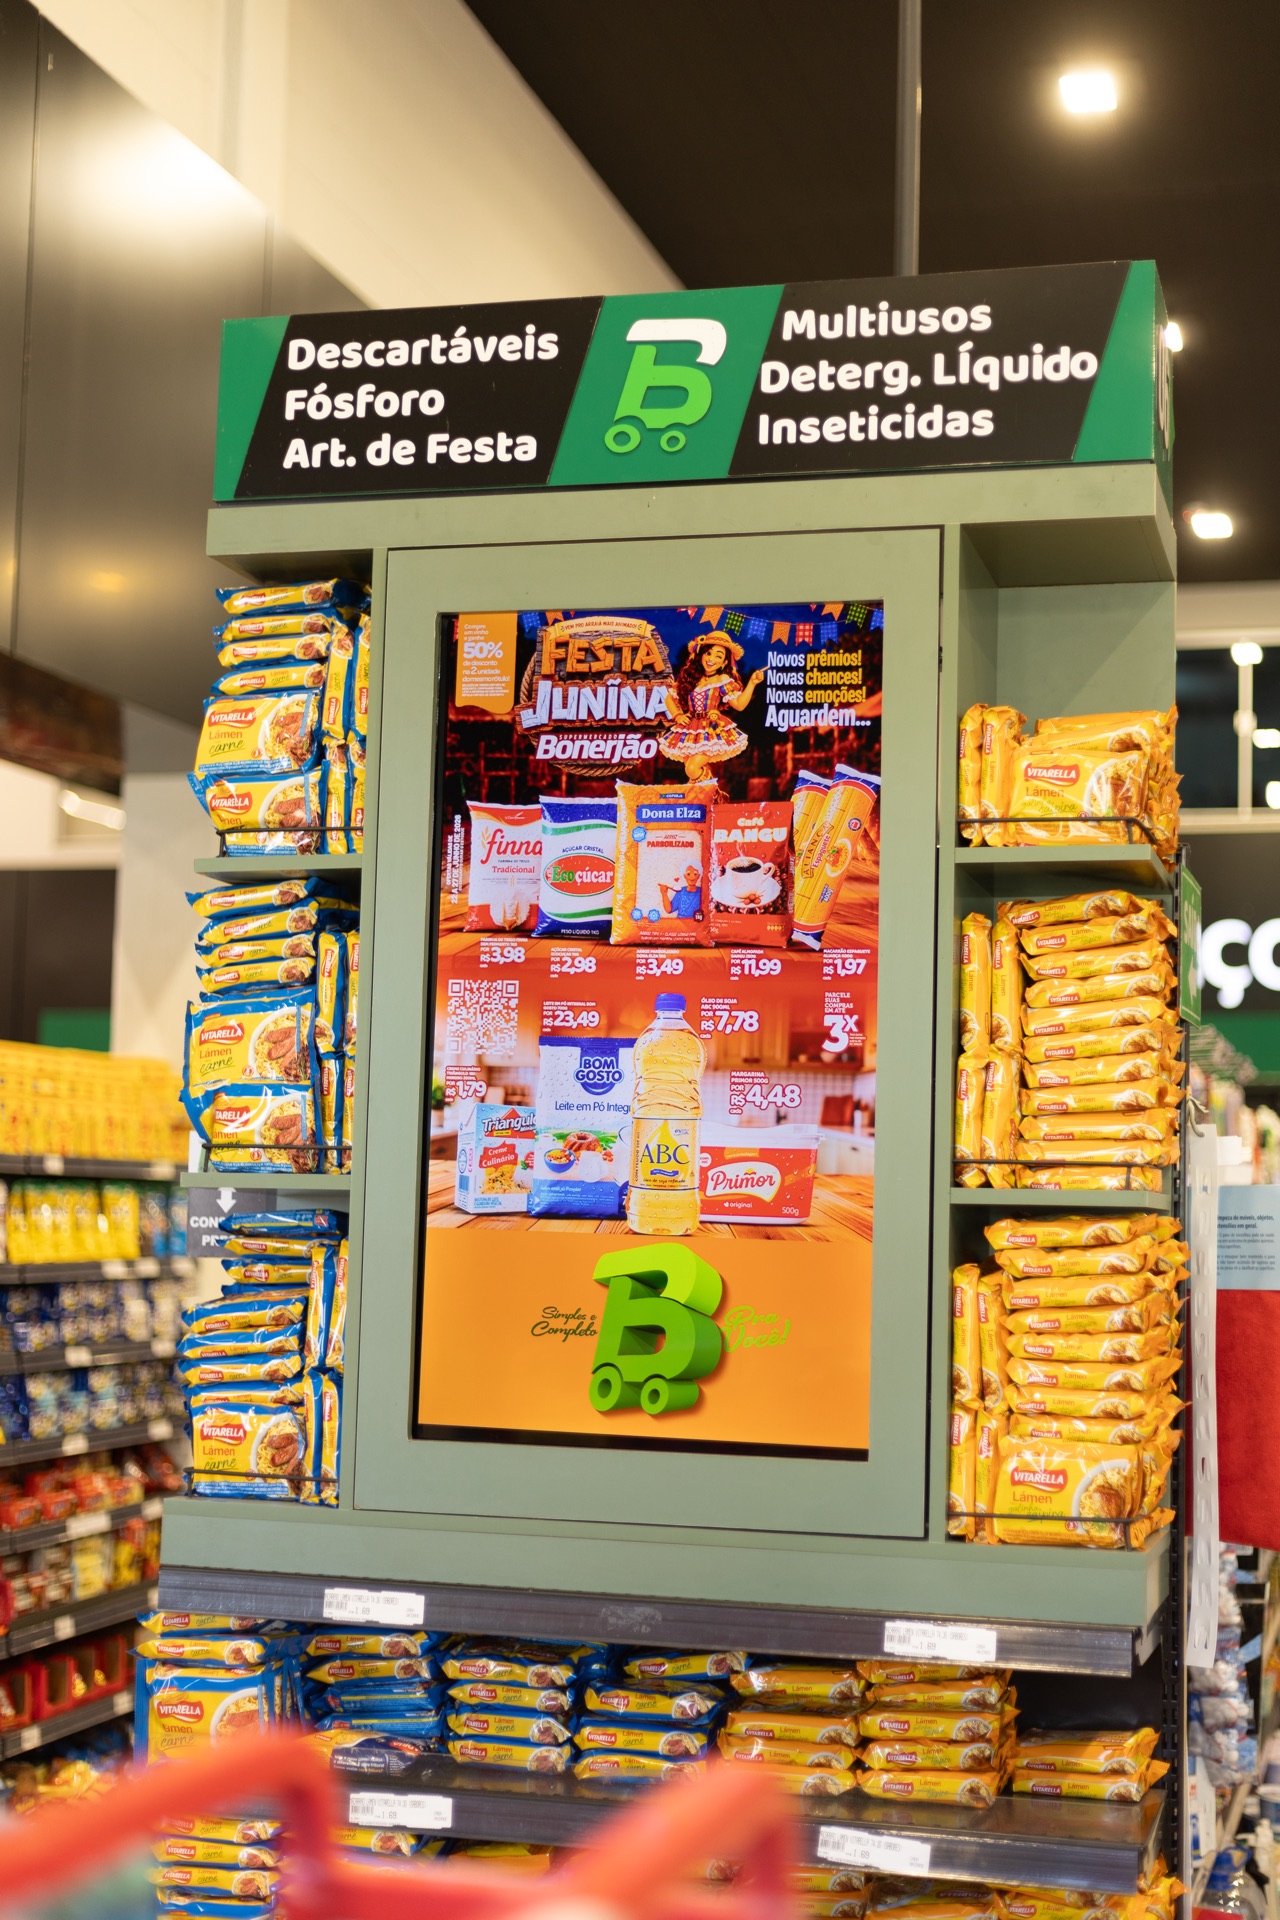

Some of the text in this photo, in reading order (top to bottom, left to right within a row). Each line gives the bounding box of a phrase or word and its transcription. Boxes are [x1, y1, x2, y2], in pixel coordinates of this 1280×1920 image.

[782, 301, 992, 340] Multiusos
[288, 324, 559, 371] Descartáveis
[760, 341, 1098, 396] Deterg. Líquido
[285, 382, 445, 420] Fósforo
[758, 403, 994, 445] Inseticidas
[283, 432, 537, 469] Art. de Festa
[463, 641, 504, 659] 50%
[541, 631, 665, 675] FESTA
[768, 650, 862, 670] Novos prêmios!
[767, 668, 862, 685] Novas chances!
[520, 678, 673, 729] JUNINA
[766, 686, 866, 707] Novas emoções!
[211, 710, 254, 725] VITARELLA
[765, 704, 871, 732] Aguardem...
[209, 730, 243, 740] Lámen
[536, 734, 657, 764] Bonerjão
[1027, 768, 1077, 780] VITARELLA
[1025, 787, 1065, 798] Lámen
[211, 797, 250, 808] VITARELLA
[642, 807, 701, 819] Dona Elza
[737, 817, 764, 827] Café
[714, 827, 787, 843] BANGU
[480, 828, 542, 865] finna
[812, 835, 831, 869] Espaguete
[492, 866, 535, 874] Tradicional
[552, 866, 613, 887] Ecoçúcar
[1037, 937, 1066, 946] VITARELLA
[491, 946, 525, 964] 3,98
[561, 956, 597, 974] 2,98
[647, 958, 684, 976] 3,49
[741, 958, 782, 977] 11,99
[834, 958, 867, 977] 1,97
[553, 1010, 600, 1029] 23,49
[701, 1010, 759, 1034] R$ 7,78
[200, 1027, 242, 1041] VITARELLA
[200, 1047, 232, 1059] Lámen
[583, 1057, 615, 1070] BOM
[575, 1070, 623, 1084] GOSTO
[731, 1084, 801, 1110] R$ 4,48
[555, 1101, 575, 1111] Leite
[576, 1103, 591, 1111] em
[593, 1101, 605, 1112] Pó
[482, 1153, 515, 1167] Culinário
[488, 1146, 508, 1156] Creme
[640, 1143, 690, 1165] ABC
[711, 1170, 776, 1191] Primor
[730, 1201, 752, 1209] original
[782, 1206, 800, 1216] 500g
[542, 1306, 587, 1324] Simples
[531, 1320, 598, 1342] Completo
[202, 1425, 245, 1439] VITARELLA
[202, 1445, 236, 1457] Lámen
[1013, 1470, 1065, 1484] VITARELLA
[1012, 1491, 1053, 1504] Lámen
[159, 1703, 201, 1716] VITARELLA
[588, 1733, 615, 1742] VITARELLA
[1032, 1786, 1061, 1794] VITARELLA
